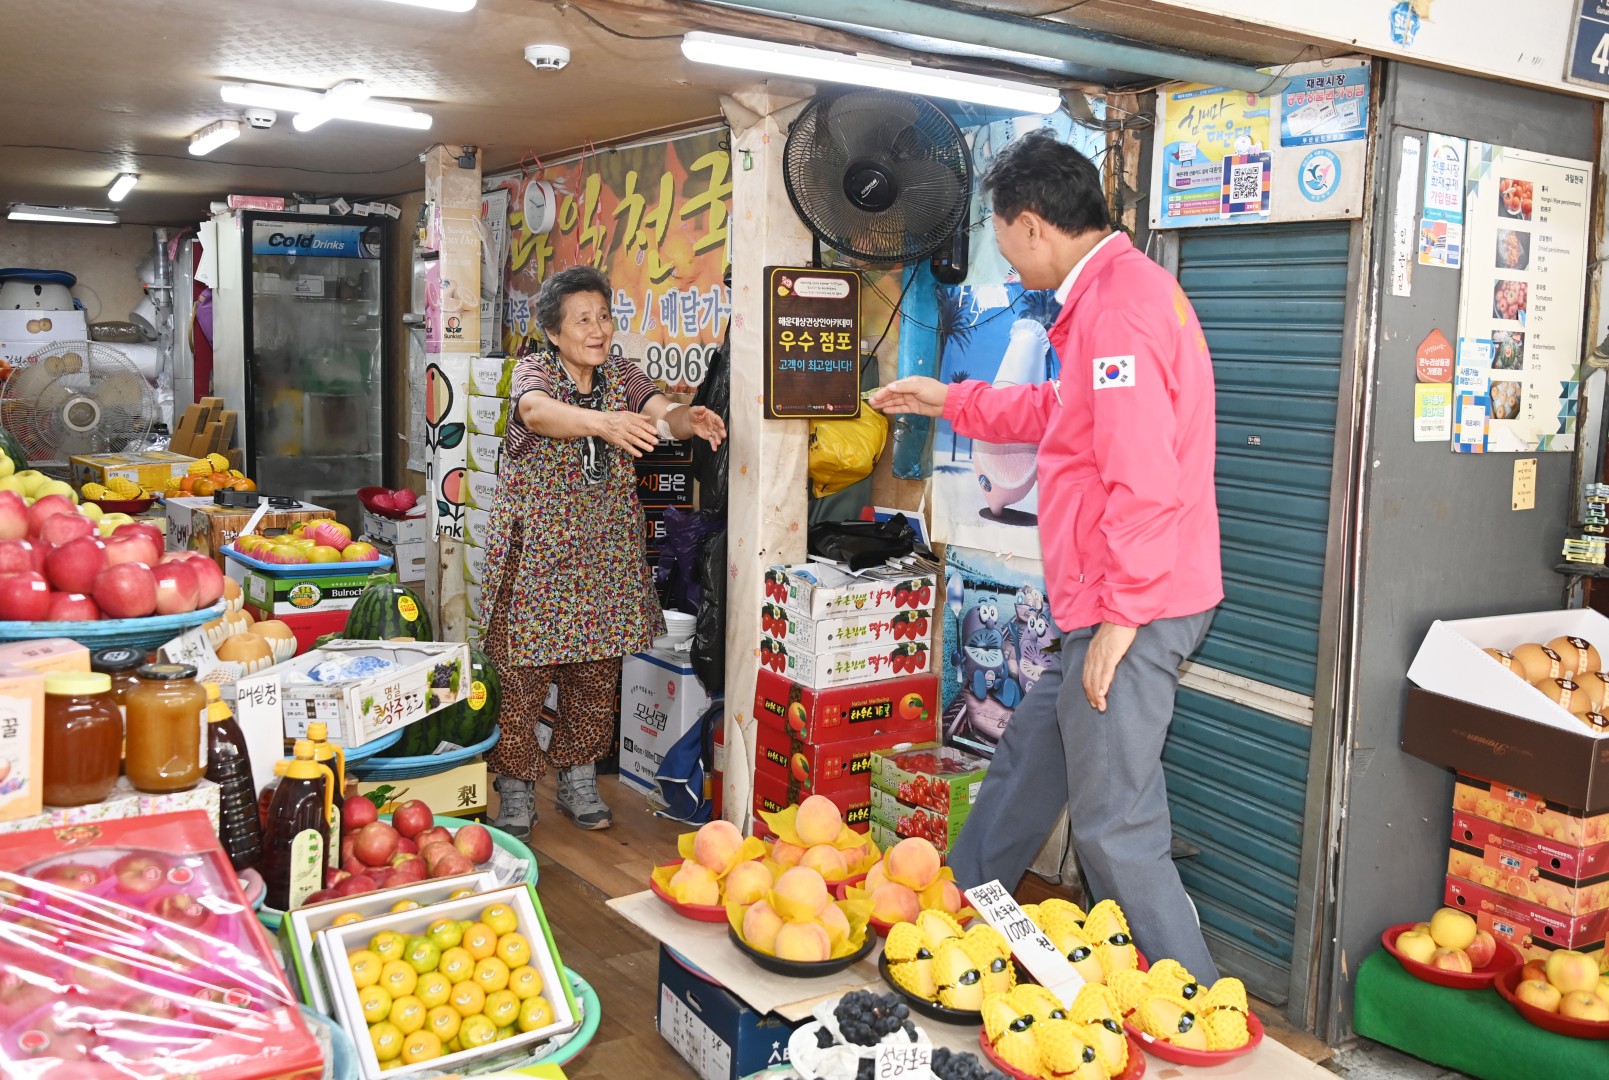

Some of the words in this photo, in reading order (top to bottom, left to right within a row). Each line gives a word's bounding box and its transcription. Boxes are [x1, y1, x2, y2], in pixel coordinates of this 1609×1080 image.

[1306, 74, 1346, 89] 재래시장
[1432, 160, 1460, 178] 전통시장
[1431, 190, 1458, 206] 가입점포
[268, 232, 315, 249] Cold
[312, 239, 345, 250] Drinks
[504, 296, 530, 336] 각종
[777, 316, 853, 329] 해운대상권상인아카데미
[444, 332, 463, 340] Sunkist
[779, 330, 815, 353] 우수
[819, 331, 853, 353] 점포
[778, 359, 806, 372] 고객이
[807, 359, 853, 373] 최고입니다!
[1419, 358, 1450, 367] 온누리상품권
[1426, 367, 1443, 376] 가맹점
[1460, 367, 1479, 377] 사용가능
[637, 473, 686, 492] 시)담은
[868, 617, 895, 641] 딸기
[868, 650, 893, 674] 딸기
[238, 682, 277, 708] 매실청
[633, 702, 668, 732] 모닝랩
[850, 706, 873, 721] 하우스
[873, 703, 892, 717] 감귤
[457, 783, 478, 808] 梨
[847, 809, 870, 822] 하우스
